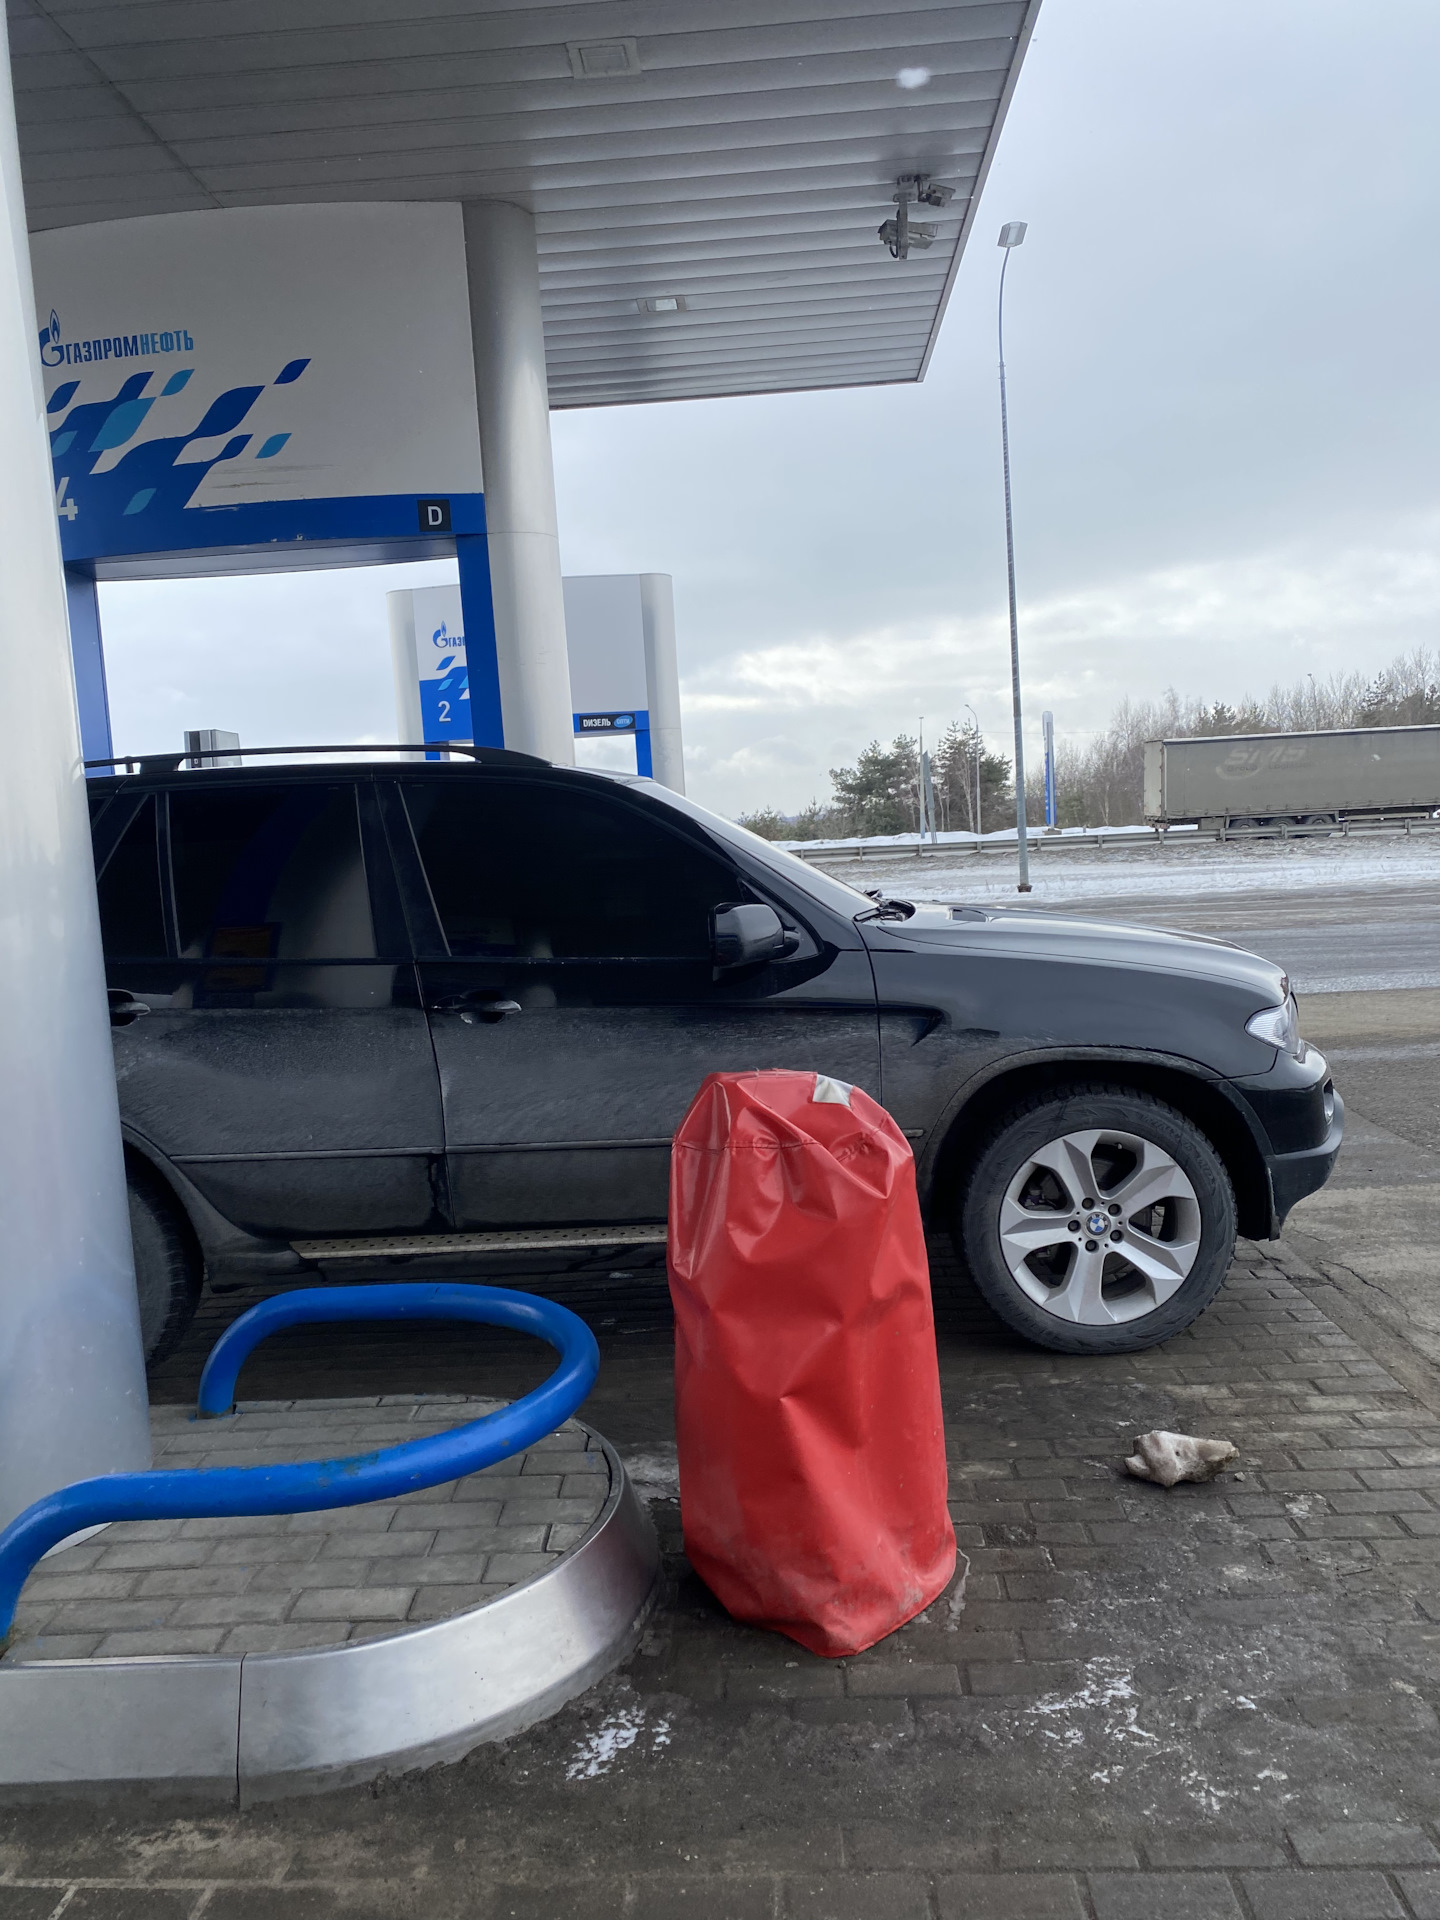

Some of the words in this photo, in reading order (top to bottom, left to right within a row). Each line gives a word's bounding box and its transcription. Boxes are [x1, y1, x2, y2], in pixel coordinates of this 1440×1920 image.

[65, 330, 194, 365] ГАЗПРОМНЕФТЬ
[56, 477, 79, 521] 4
[427, 505, 443, 526] D
[437, 700, 451, 722] 2
